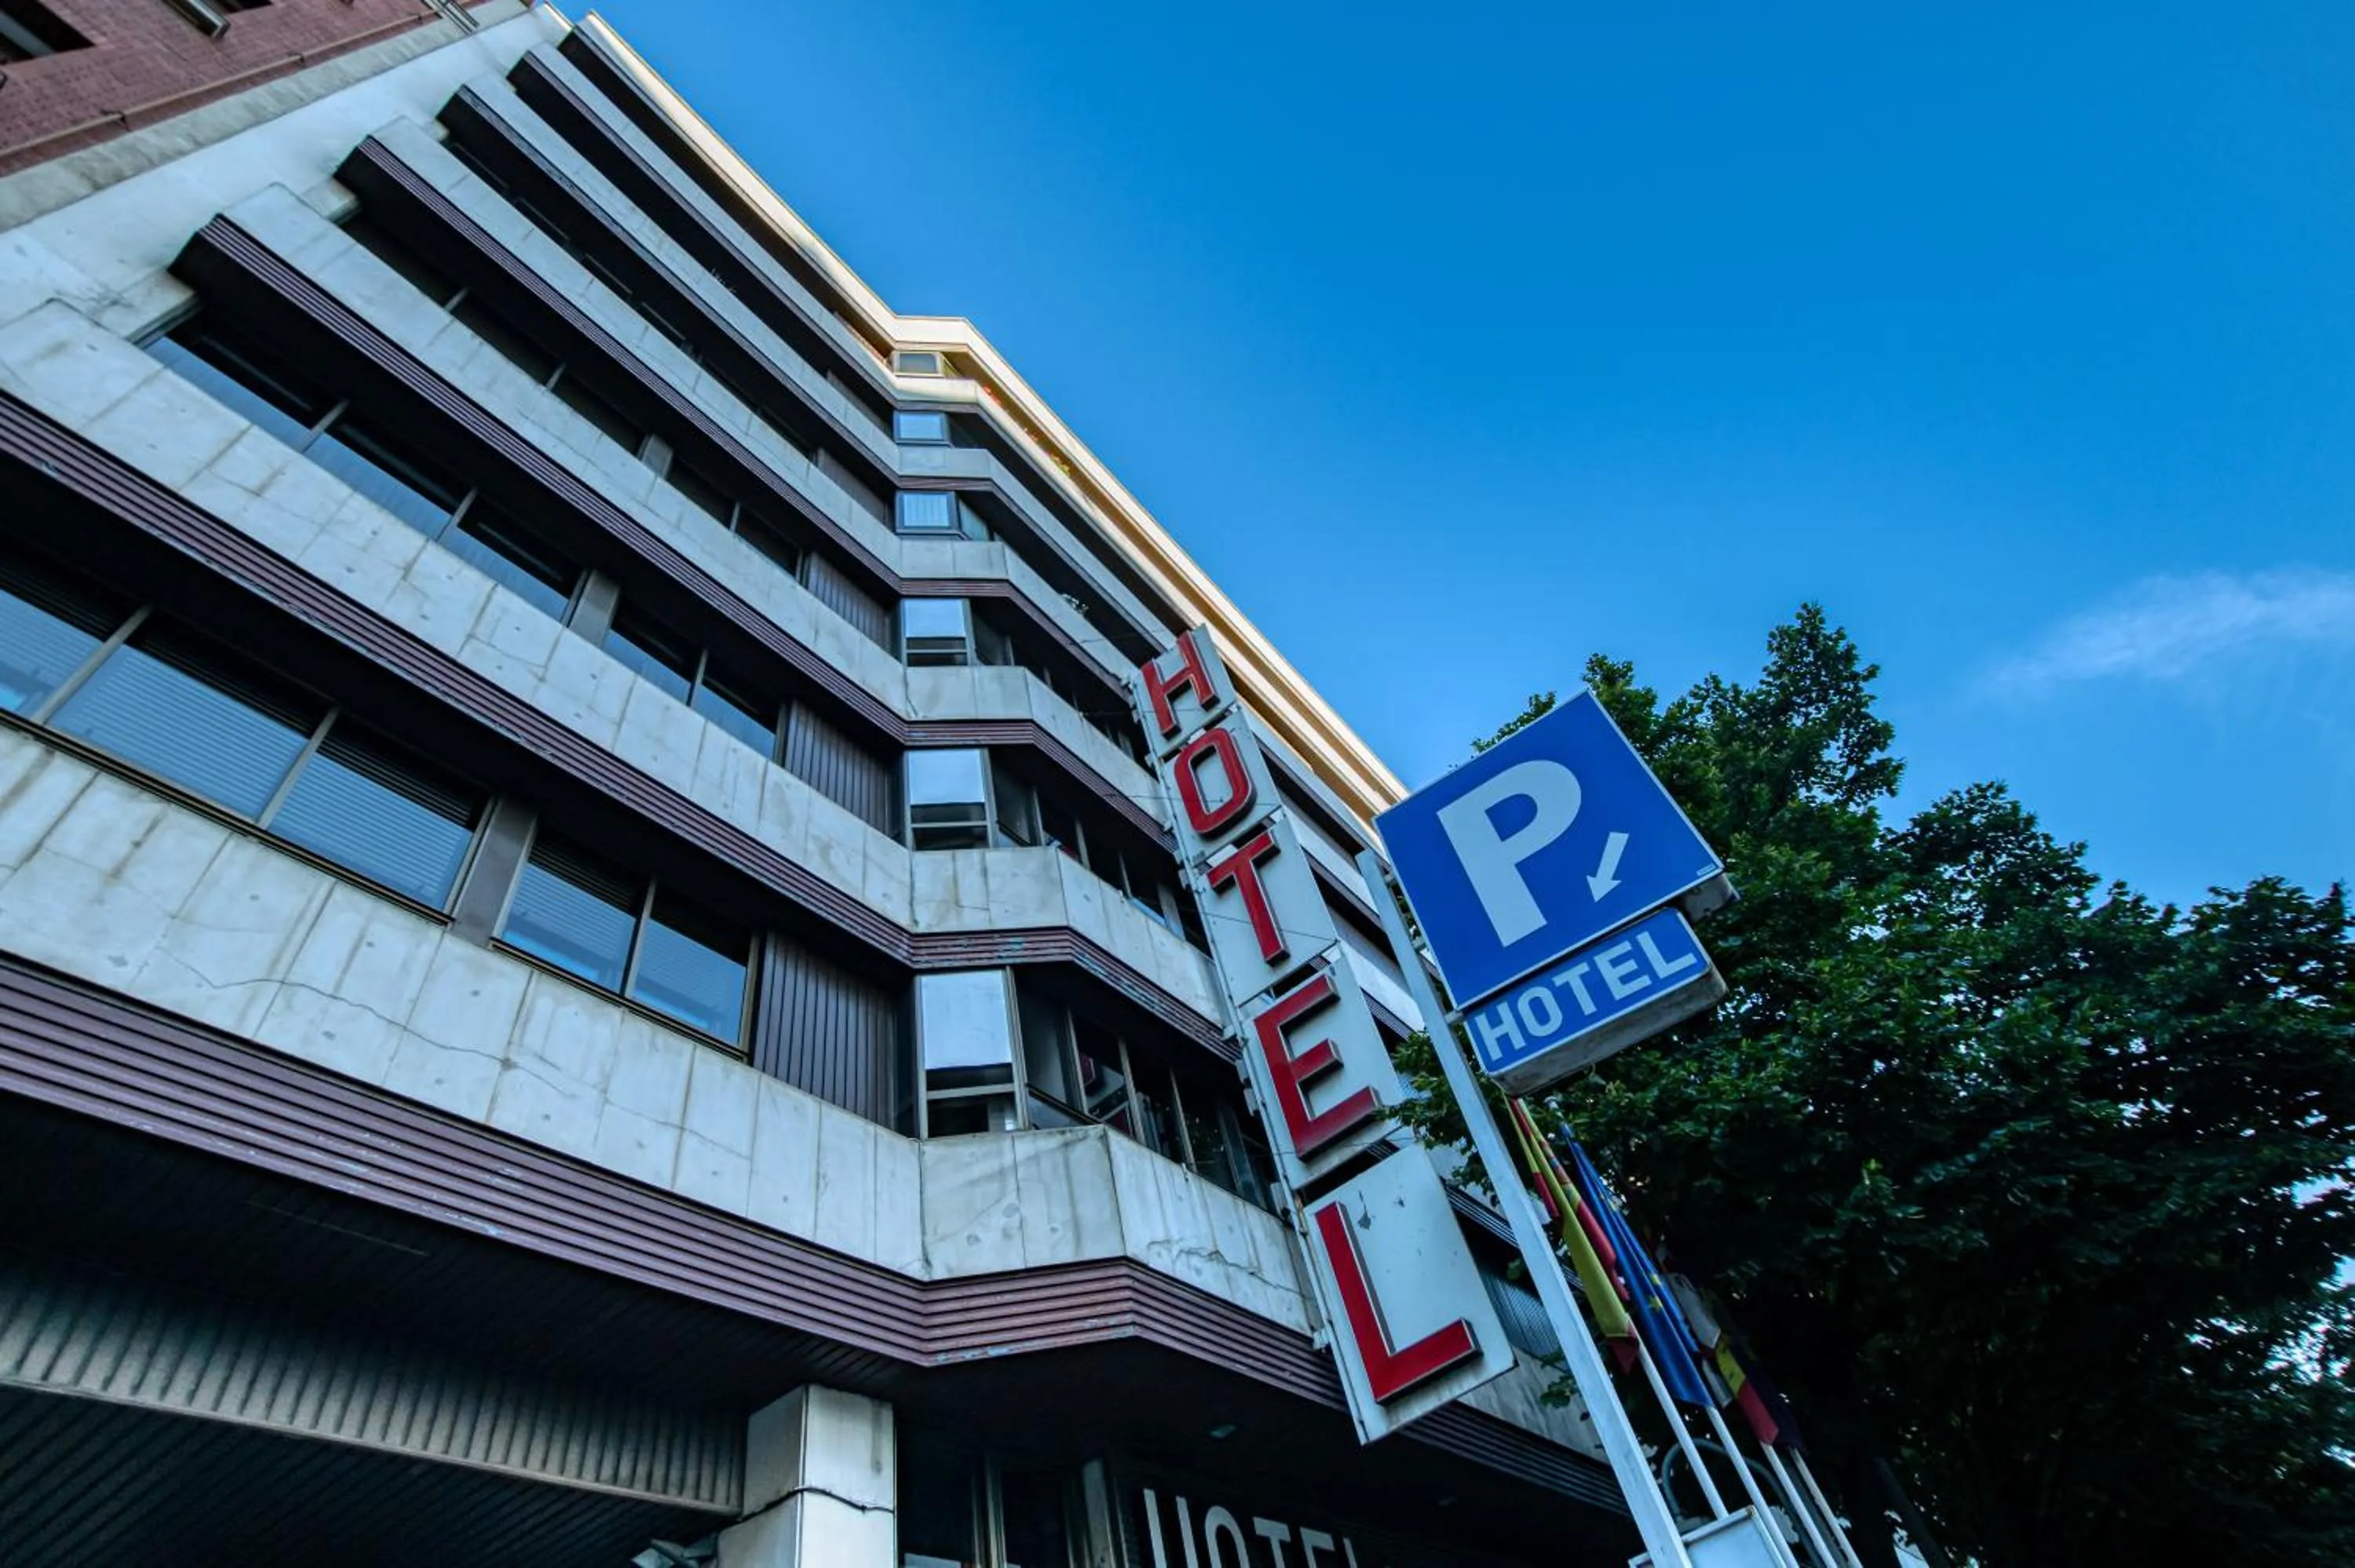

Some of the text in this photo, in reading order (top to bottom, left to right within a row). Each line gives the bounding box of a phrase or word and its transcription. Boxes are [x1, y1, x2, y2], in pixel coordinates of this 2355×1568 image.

[1436, 759, 1582, 948] P
[1141, 629, 1483, 1405] HOTEL
[1474, 929, 1697, 1061] HOTEL
